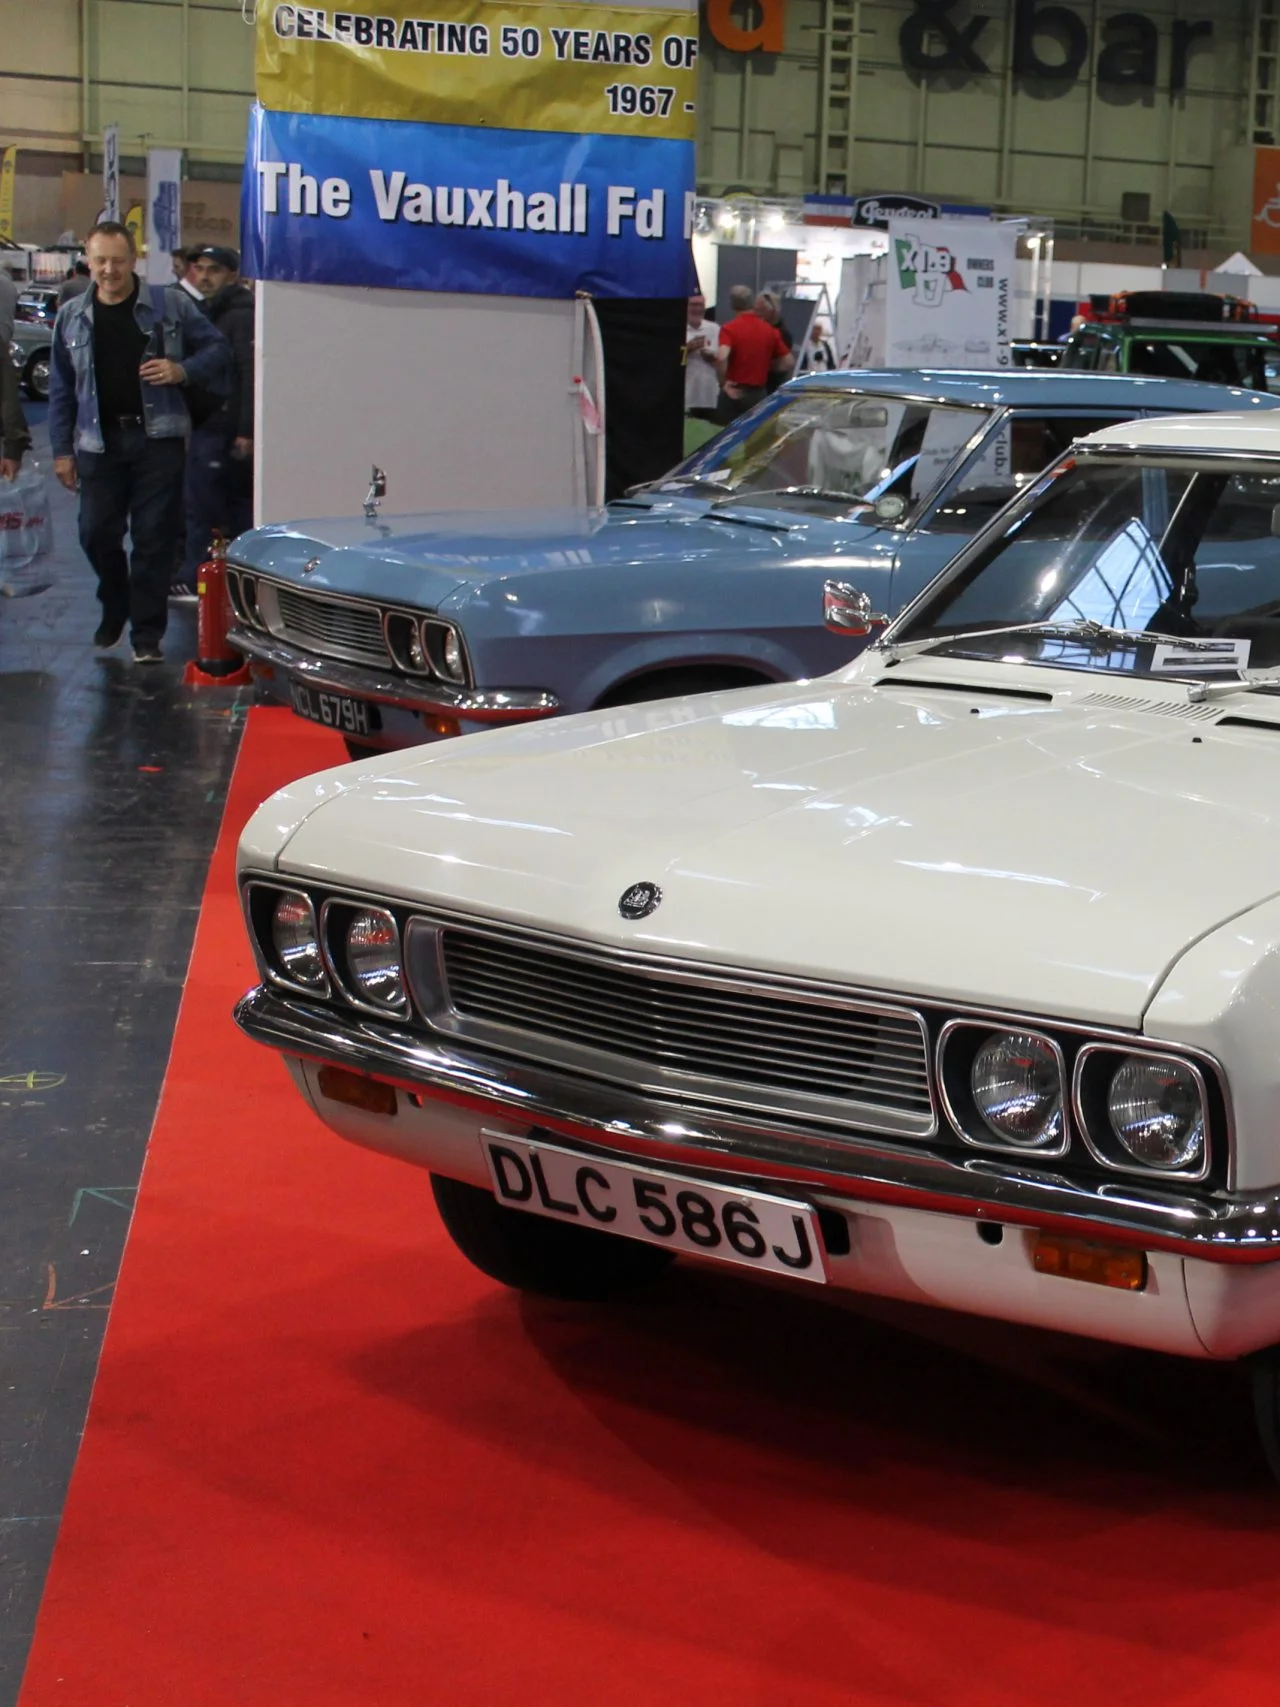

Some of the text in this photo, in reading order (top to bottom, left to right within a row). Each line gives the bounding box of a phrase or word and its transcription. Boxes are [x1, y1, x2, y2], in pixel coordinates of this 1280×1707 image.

[273, 5, 697, 69] CELEBRATING 50 YEARS OF
[605, 83, 676, 117] 1967
[258, 161, 351, 218] The
[369, 169, 588, 234] Vauxhall
[607, 185, 665, 239] Fd
[319, 693, 368, 735] 679H
[487, 1143, 814, 1270] DLC 586J
